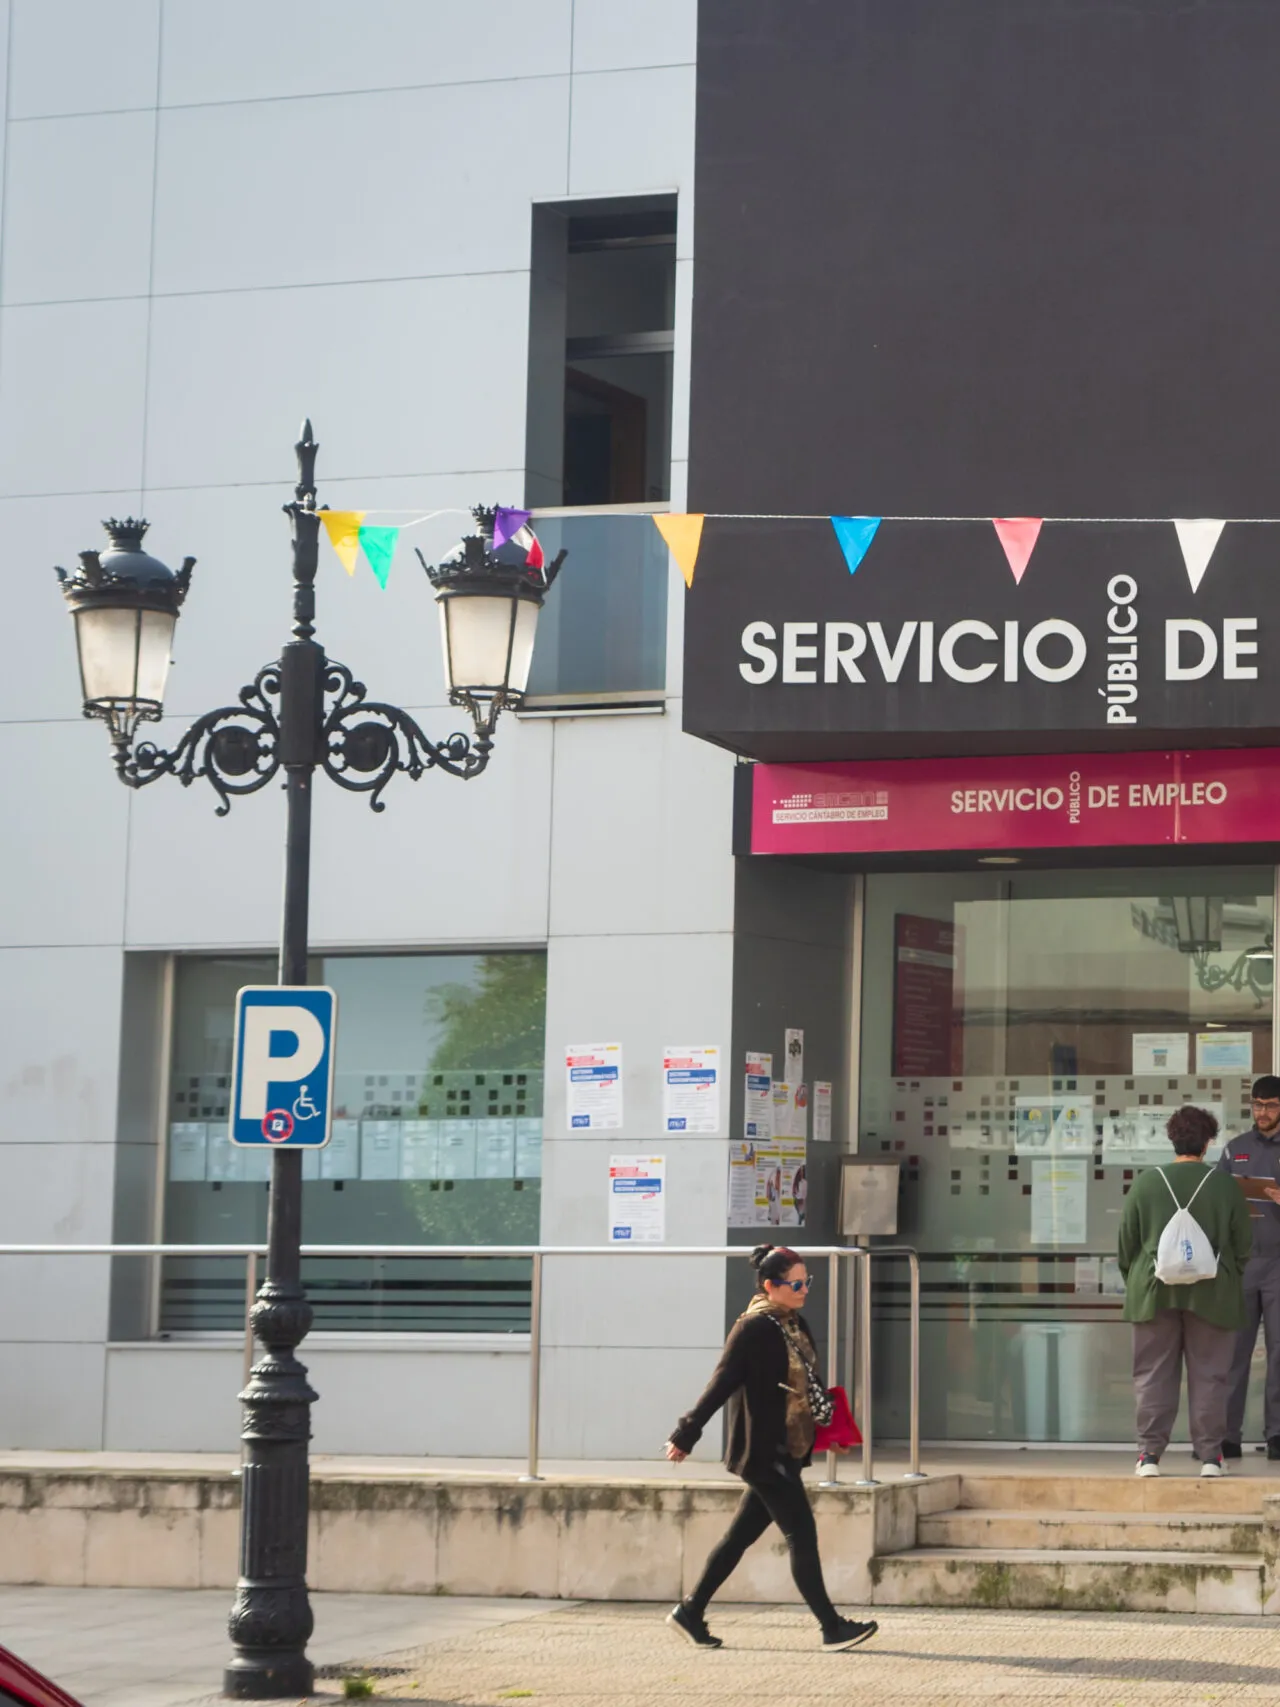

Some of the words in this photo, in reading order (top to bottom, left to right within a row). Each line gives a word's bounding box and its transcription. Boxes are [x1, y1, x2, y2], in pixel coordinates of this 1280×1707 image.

[739, 618, 1087, 685] SERVICIO
[1098, 574, 1138, 724] PÚBLICO
[1165, 617, 1258, 681] DE
[776, 812, 807, 821] SERVICIO
[847, 810, 857, 819] DE
[858, 809, 885, 819] EMPLEO
[951, 787, 1064, 813] SERVICIO
[1066, 771, 1081, 824] PÚBLICO
[1088, 785, 1119, 808] DE
[1129, 782, 1227, 807] EMPLEO
[239, 1005, 325, 1119] P
